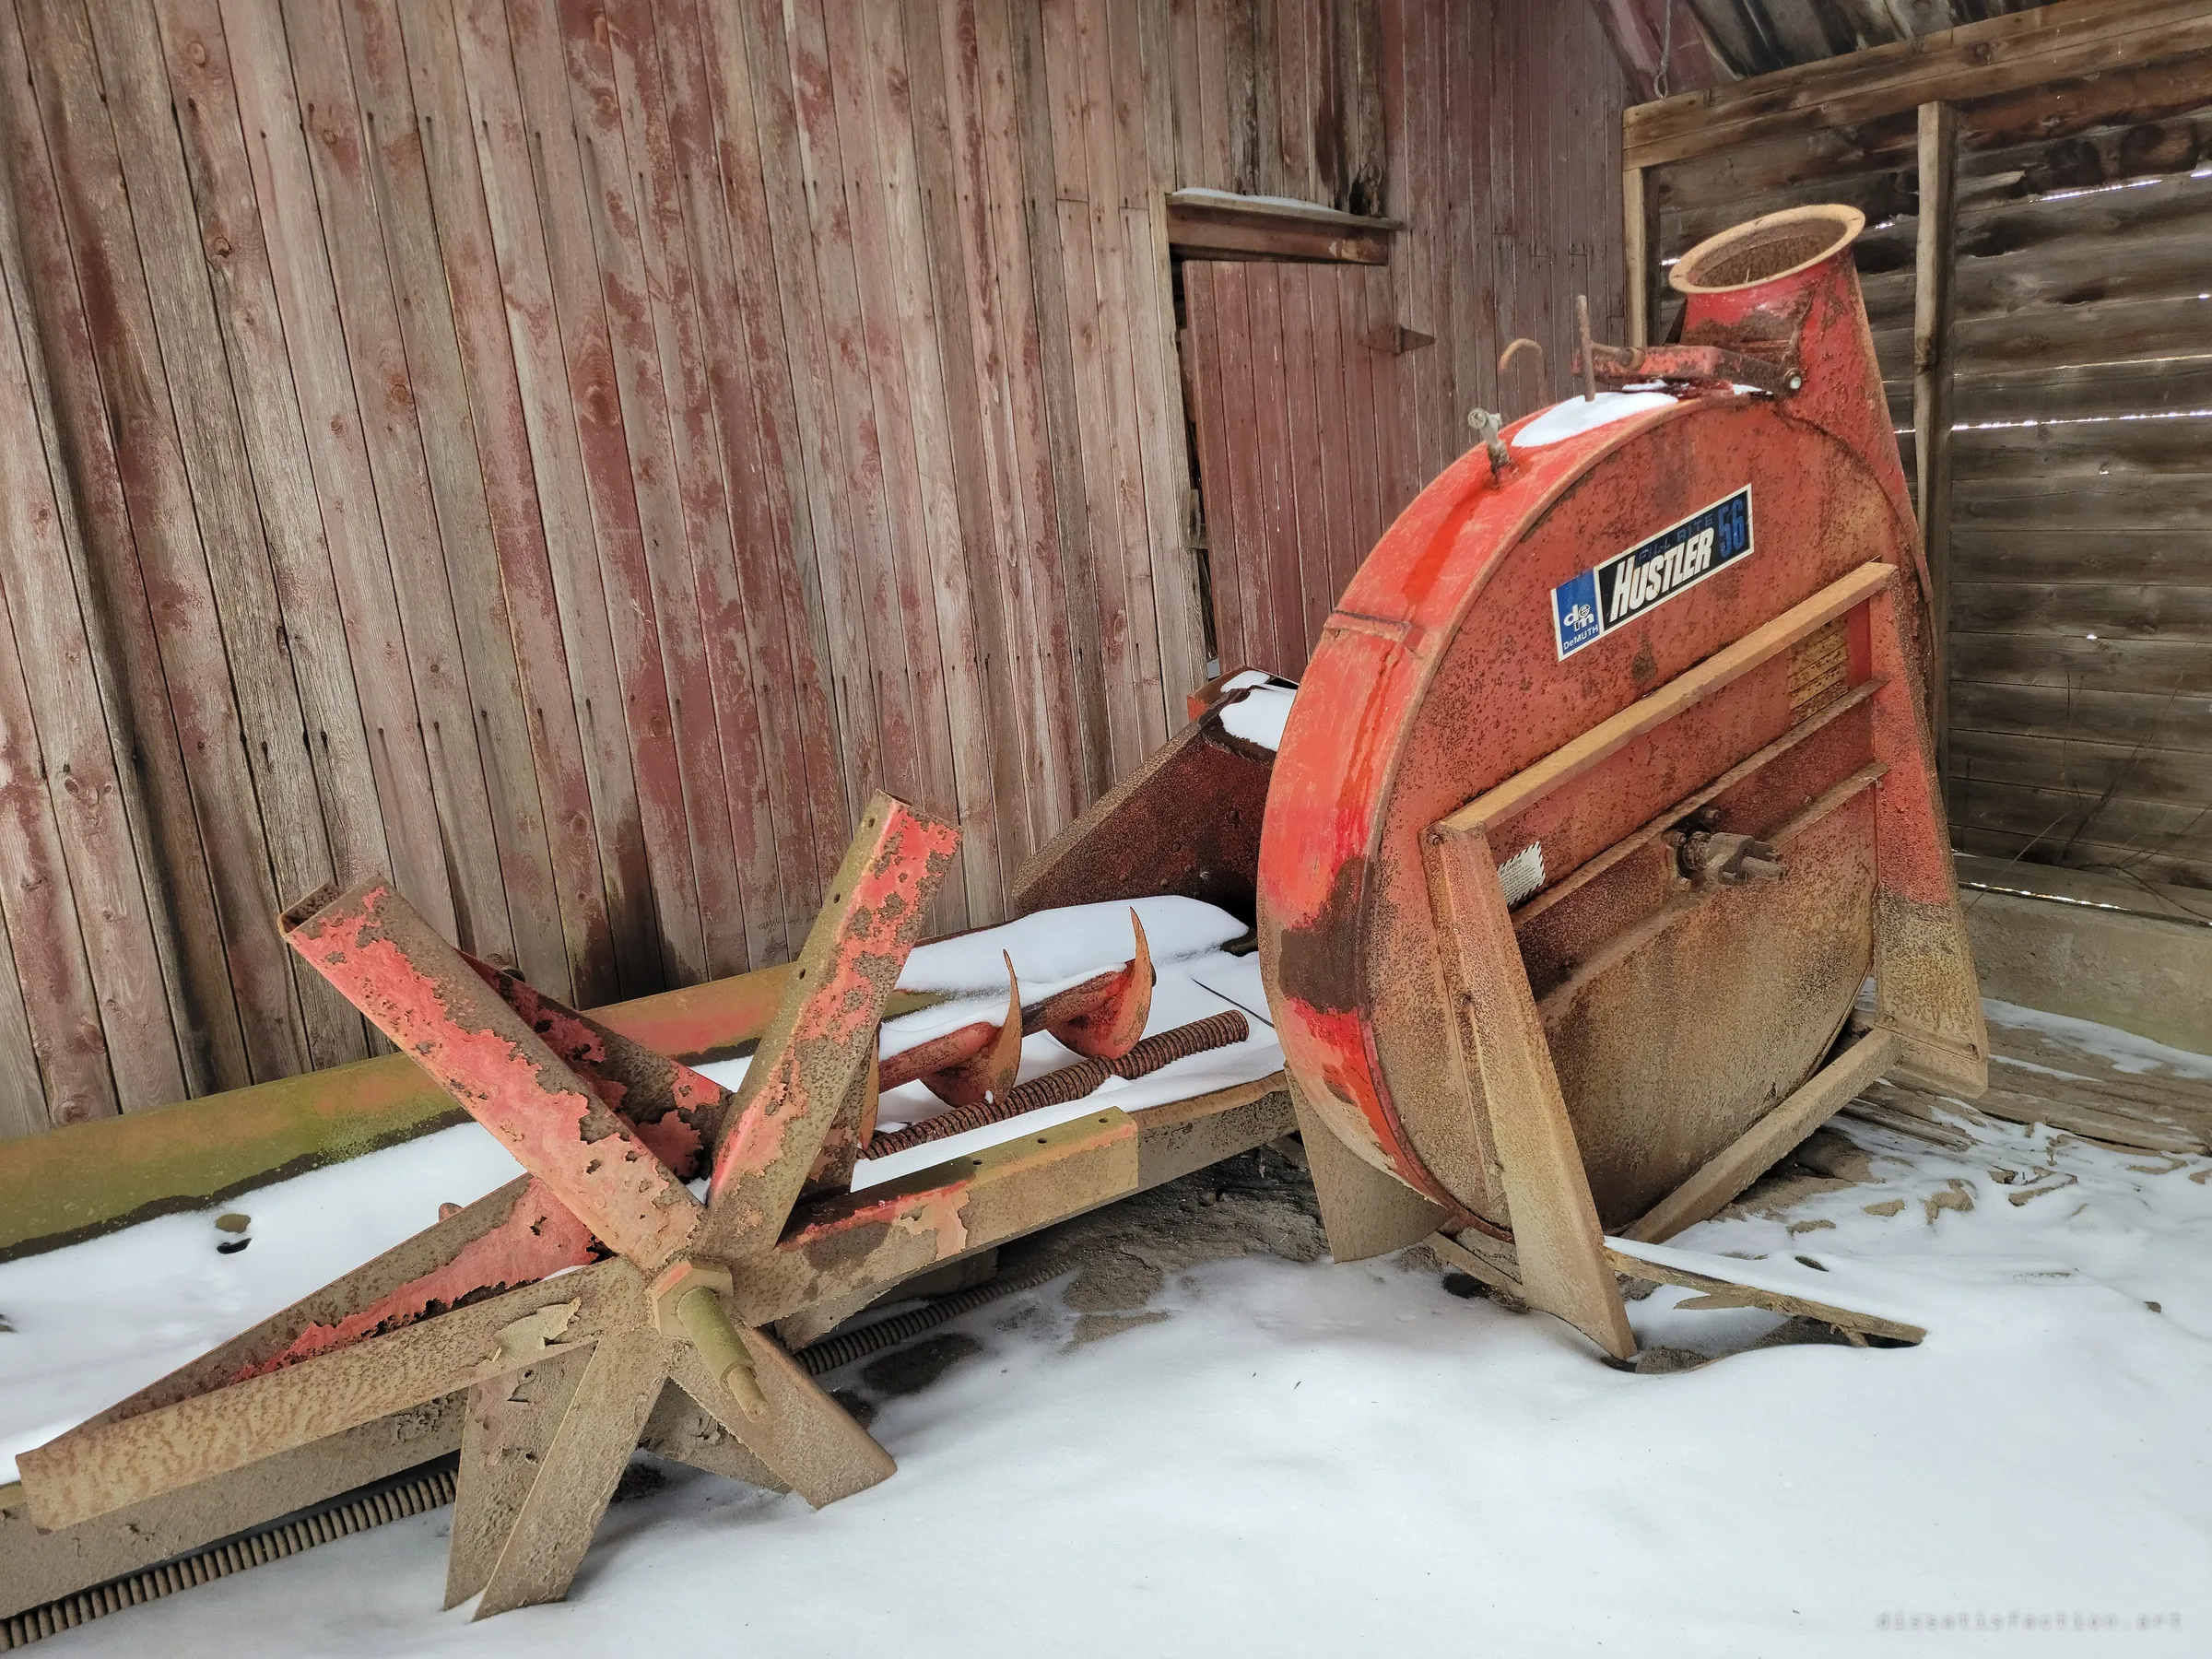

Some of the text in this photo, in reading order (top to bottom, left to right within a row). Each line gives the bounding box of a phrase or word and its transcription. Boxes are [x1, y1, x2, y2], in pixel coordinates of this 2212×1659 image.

[1677, 513, 1713, 542] RITE
[1717, 498, 1745, 558] 56
[1563, 624, 1599, 651] DeMUTH
